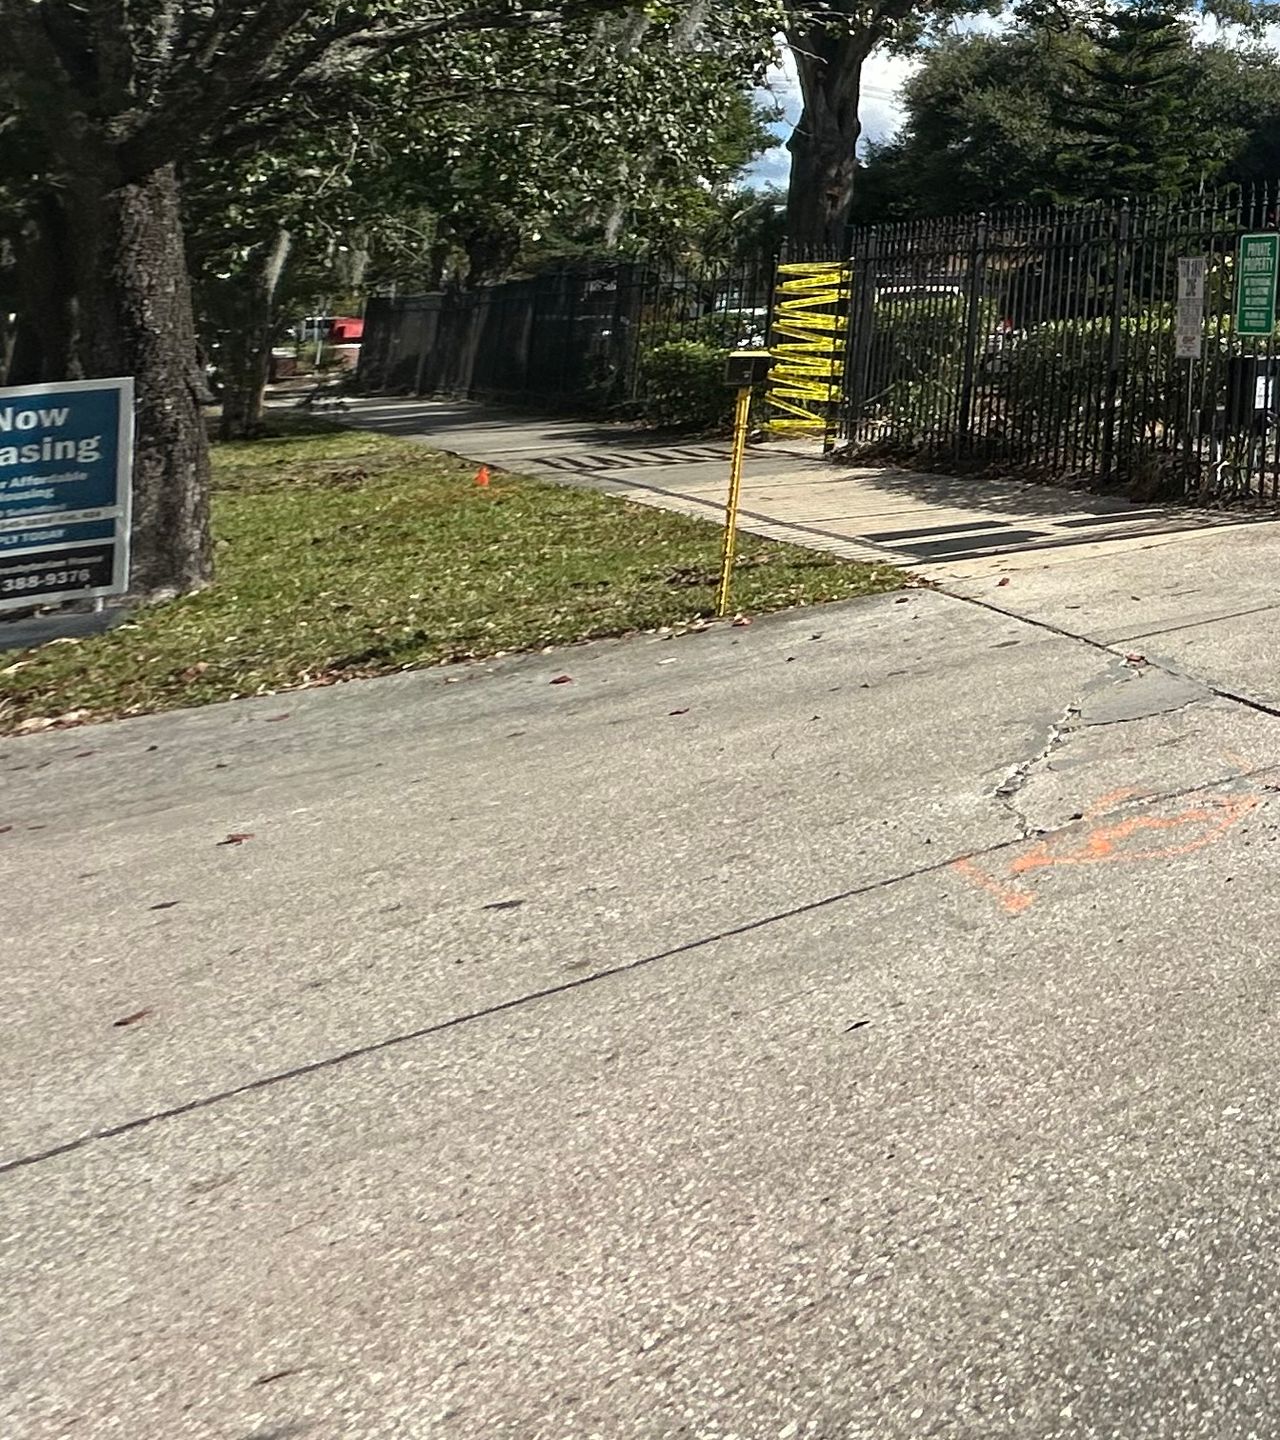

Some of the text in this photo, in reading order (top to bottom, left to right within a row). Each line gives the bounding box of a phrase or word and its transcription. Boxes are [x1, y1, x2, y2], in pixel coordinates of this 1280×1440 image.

[1247, 242, 1272, 257] PRIVATE
[1243, 257, 1274, 272] PROPERTY
[0, 407, 70, 431] Now
[2, 568, 91, 592] 388-9376
